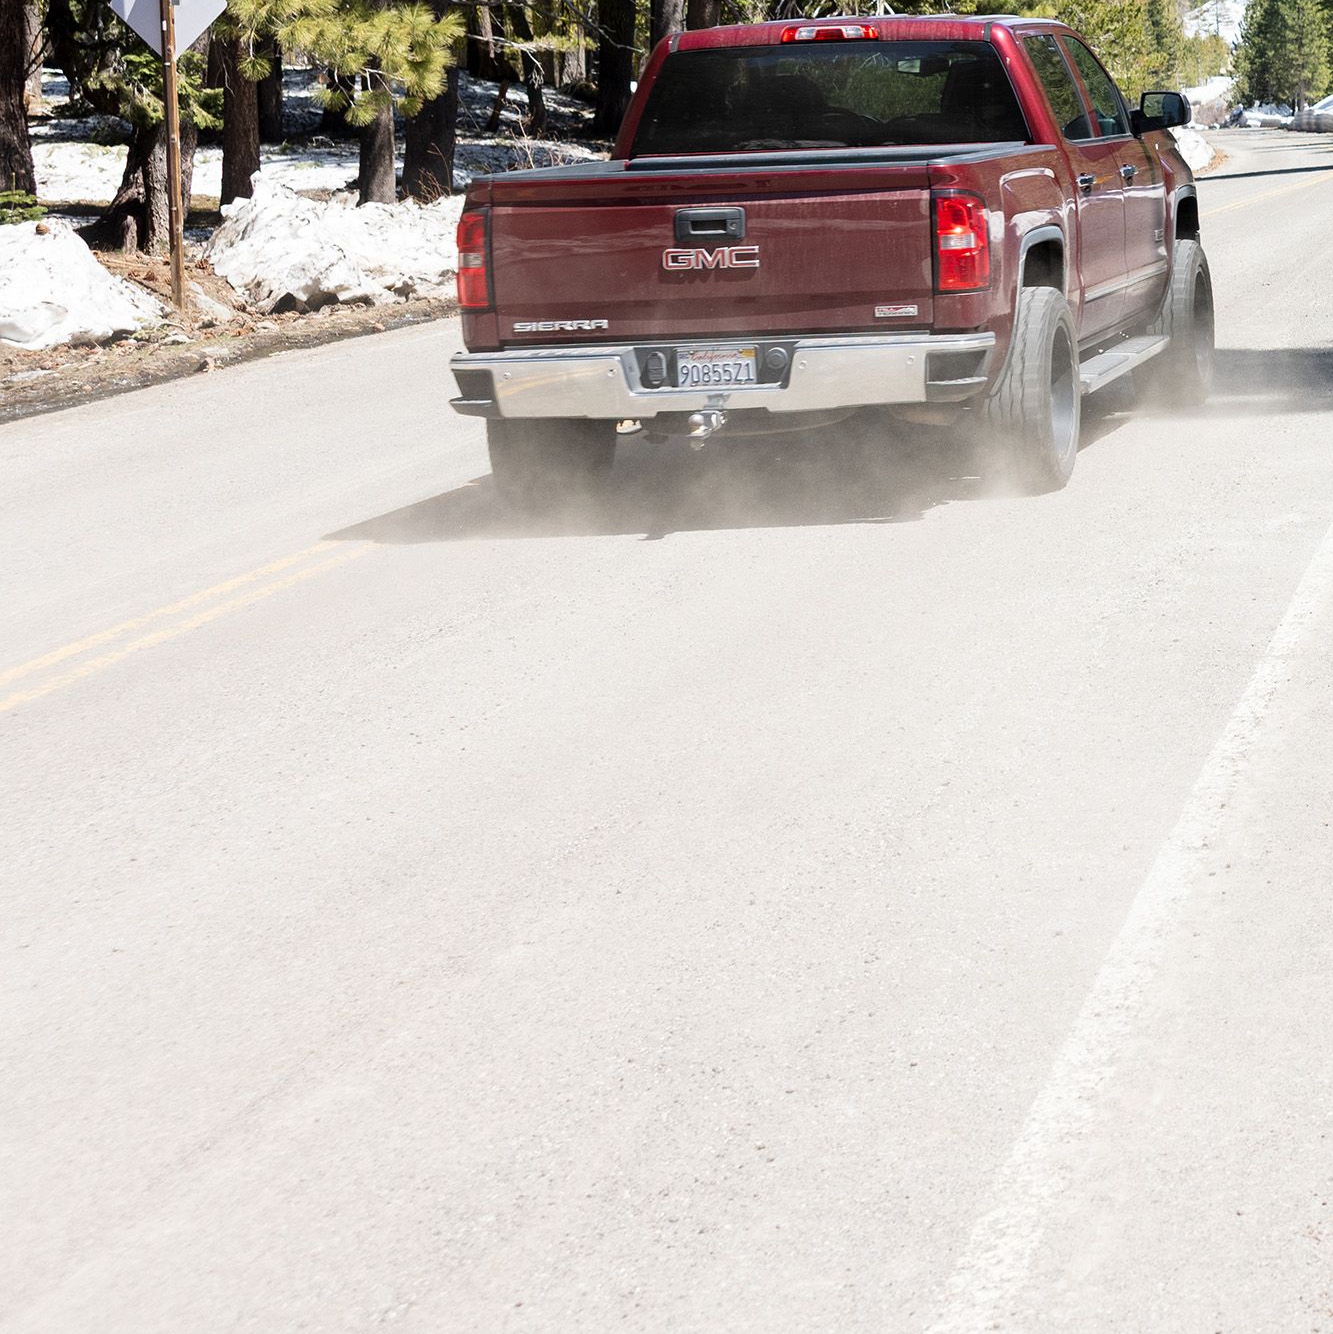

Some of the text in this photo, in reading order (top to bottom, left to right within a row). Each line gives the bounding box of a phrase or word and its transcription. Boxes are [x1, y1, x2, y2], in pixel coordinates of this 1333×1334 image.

[662, 246, 760, 270] GMC
[513, 319, 609, 332] SIERRA
[691, 351, 738, 362] California
[681, 362, 755, 384] 90855Z1
